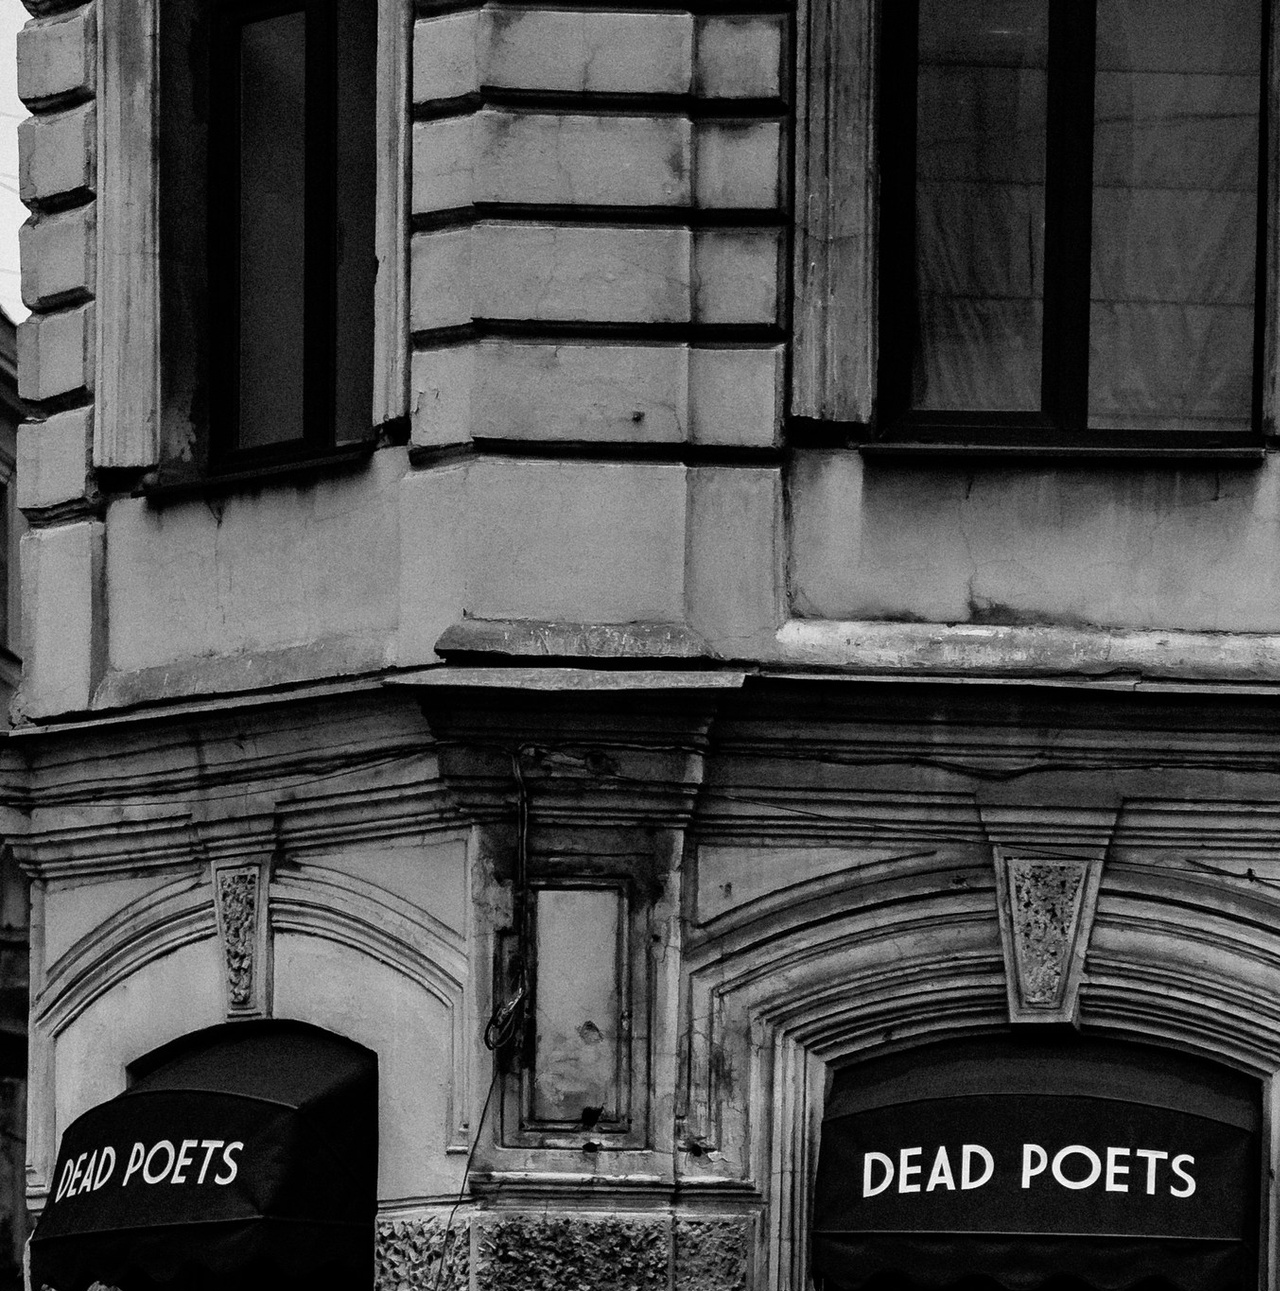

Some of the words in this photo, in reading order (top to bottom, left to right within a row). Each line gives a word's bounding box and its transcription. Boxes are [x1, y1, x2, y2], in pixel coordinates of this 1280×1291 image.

[54, 1145, 117, 1204] DEAD
[121, 1139, 245, 1187] POETS
[862, 1143, 995, 1198] DEAD
[1021, 1143, 1197, 1198] POETS
